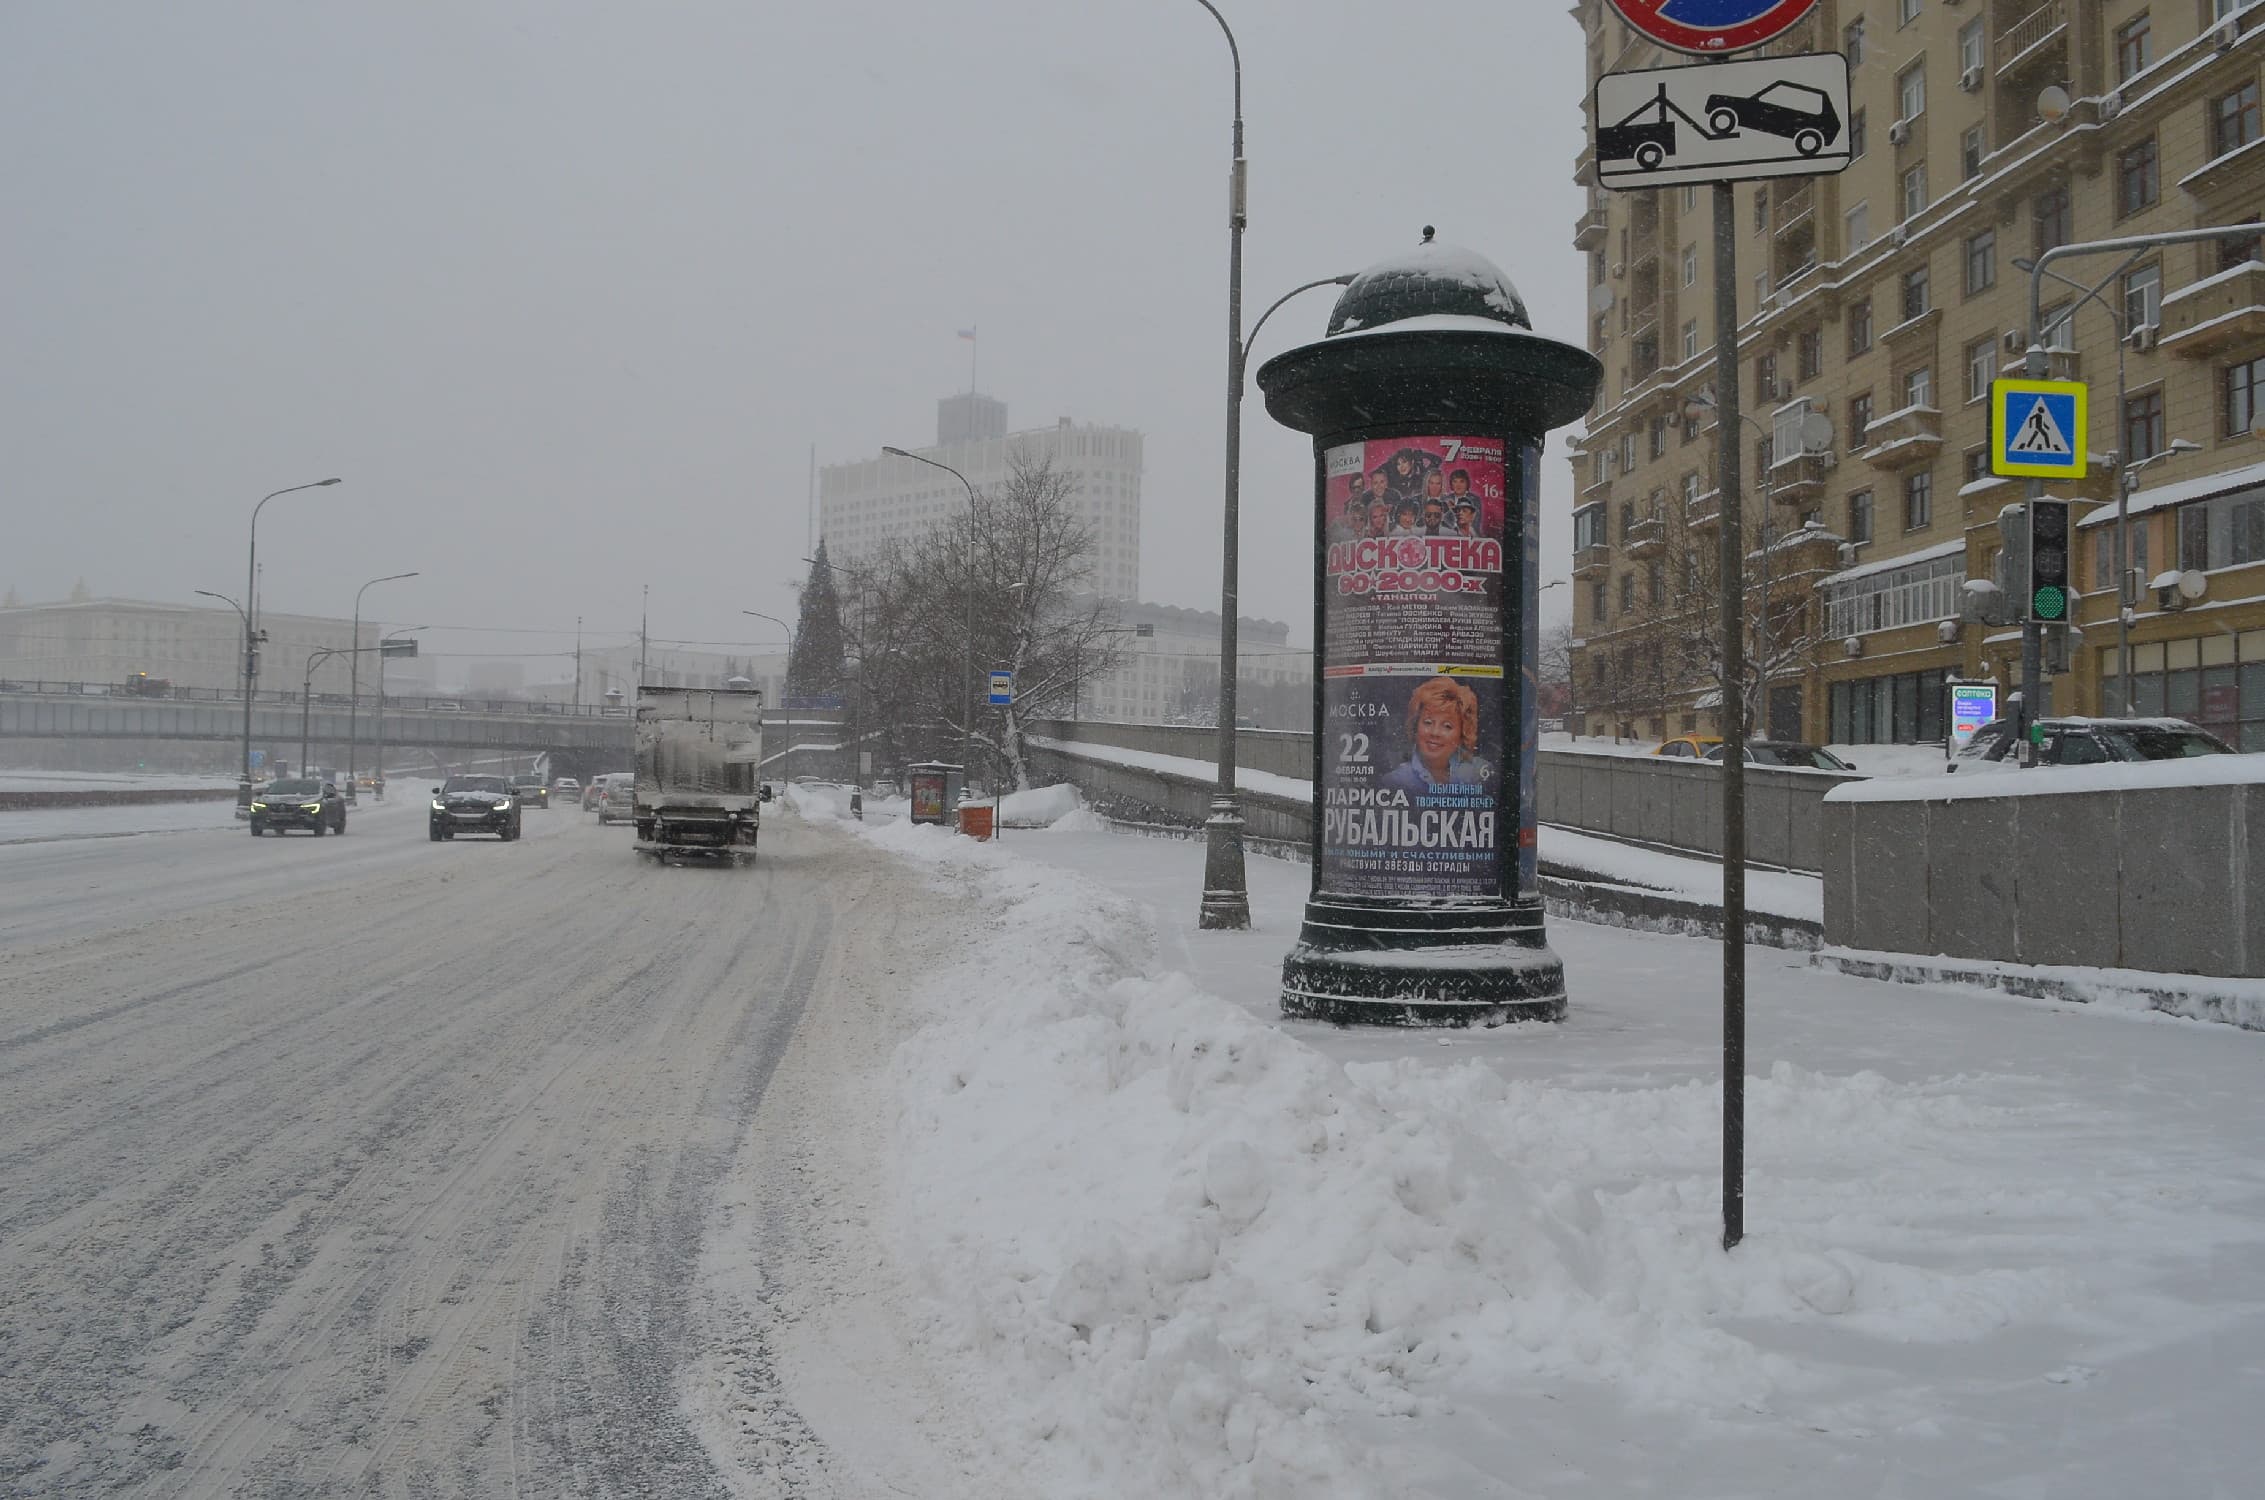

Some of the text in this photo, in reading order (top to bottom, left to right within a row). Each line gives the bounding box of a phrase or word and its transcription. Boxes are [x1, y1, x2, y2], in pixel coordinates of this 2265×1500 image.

[1439, 439, 1462, 462] 7
[1460, 446, 1502, 457] ФЕВРАЛЯ
[1327, 537, 1502, 576] ДИСКОТЕКА
[1329, 704, 1390, 718] МОСКВА
[1339, 732, 1369, 763] 22
[1335, 765, 1374, 776] ФЕВРАЛЯ
[1428, 783, 1483, 795] ЮБИЛЕЙНЫЙ
[1325, 787, 1410, 807] ЛАРИСА
[1416, 796, 1495, 808] ТВОРЧЕСКИЙ ВЕЧЕР
[1325, 808, 1495, 849] РУБАЛЬСКАЯ
[1426, 861, 1470, 874] ЭСТРАДЫ
